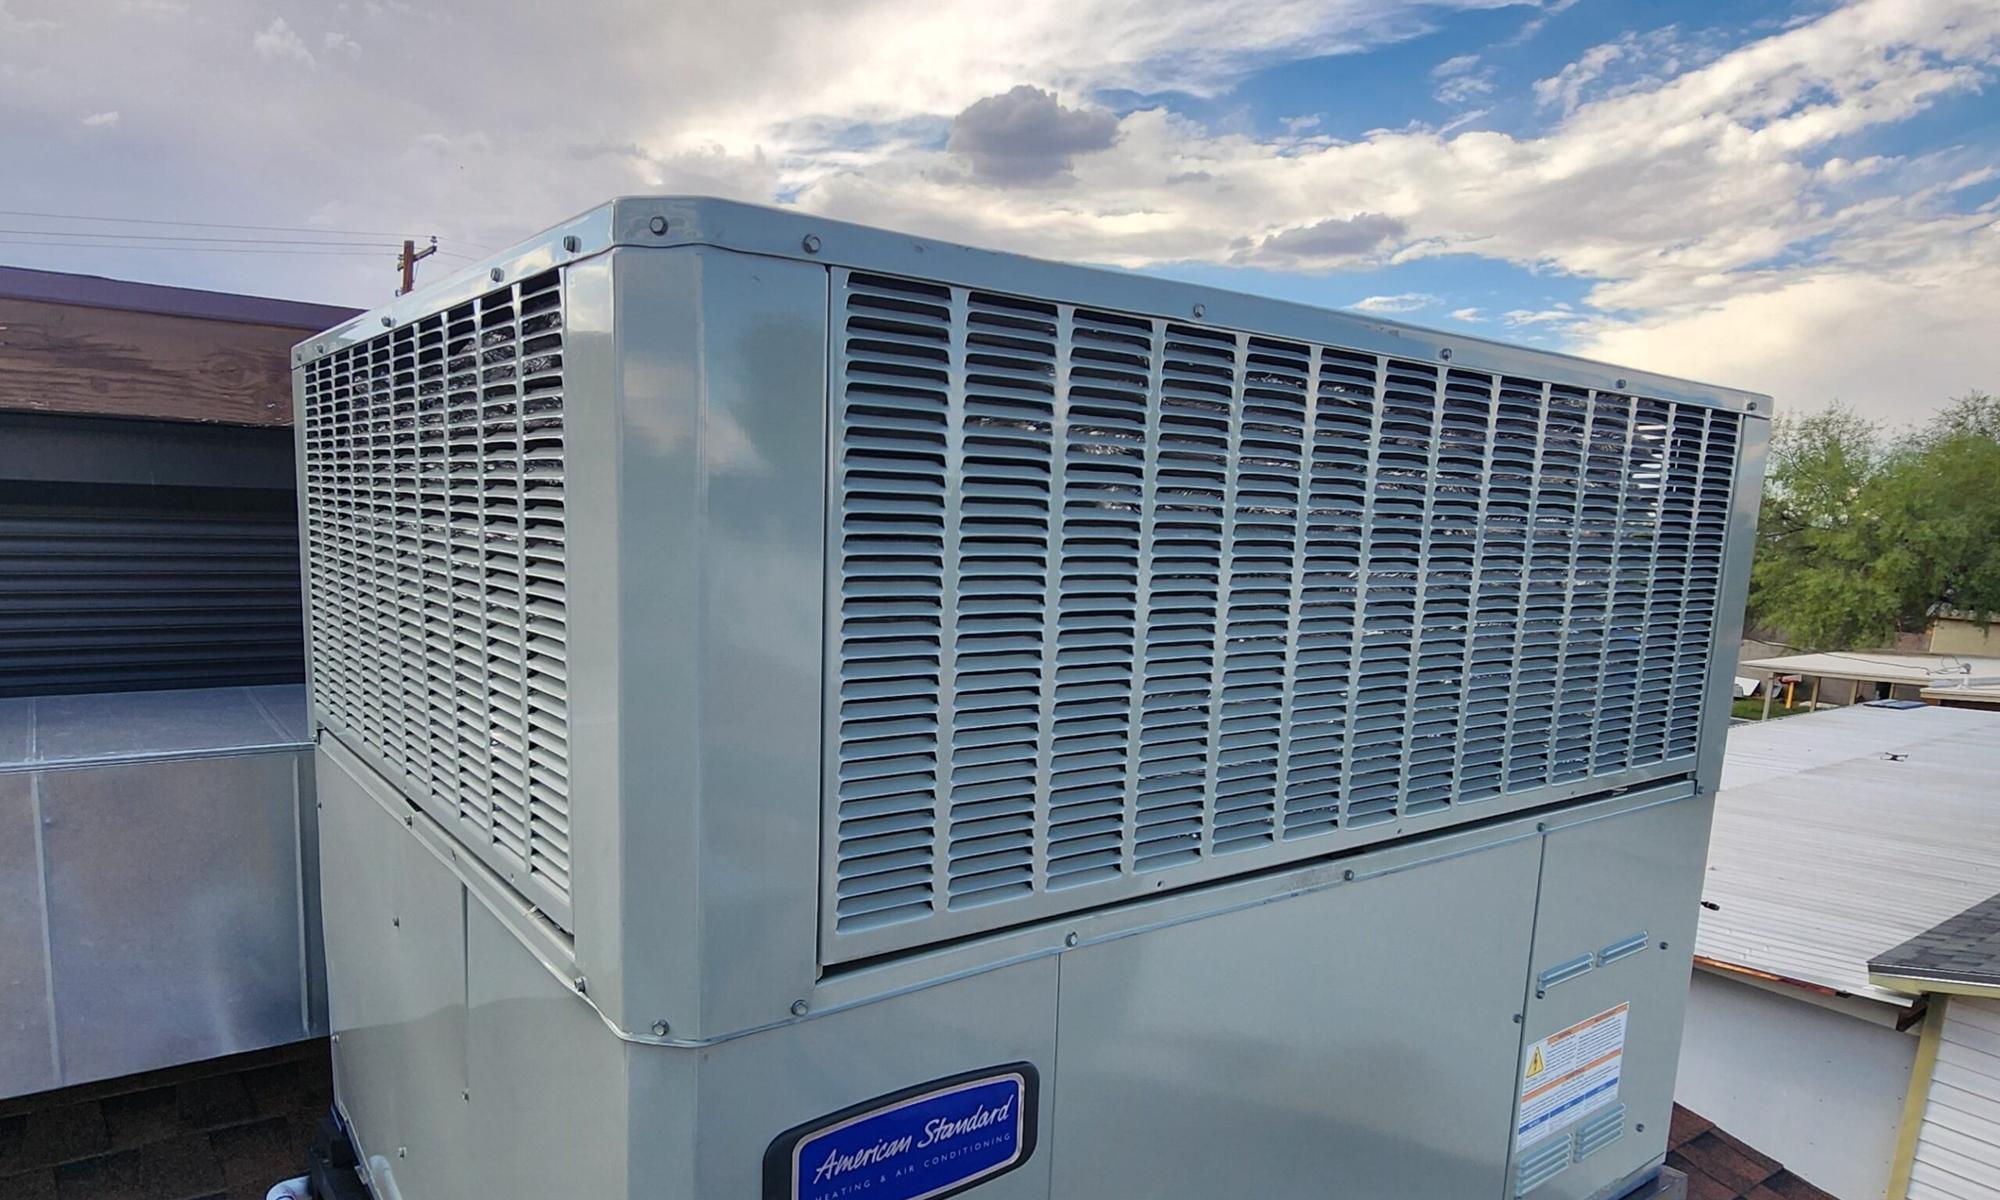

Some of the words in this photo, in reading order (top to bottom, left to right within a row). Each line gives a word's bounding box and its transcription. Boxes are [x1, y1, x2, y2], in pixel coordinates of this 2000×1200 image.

[813, 1135, 912, 1184] American
[917, 1094, 1014, 1148] Standard
[880, 1174, 887, 1182] &
[895, 1165, 915, 1178] AIR
[924, 1132, 1011, 1168] CONDITIONING
